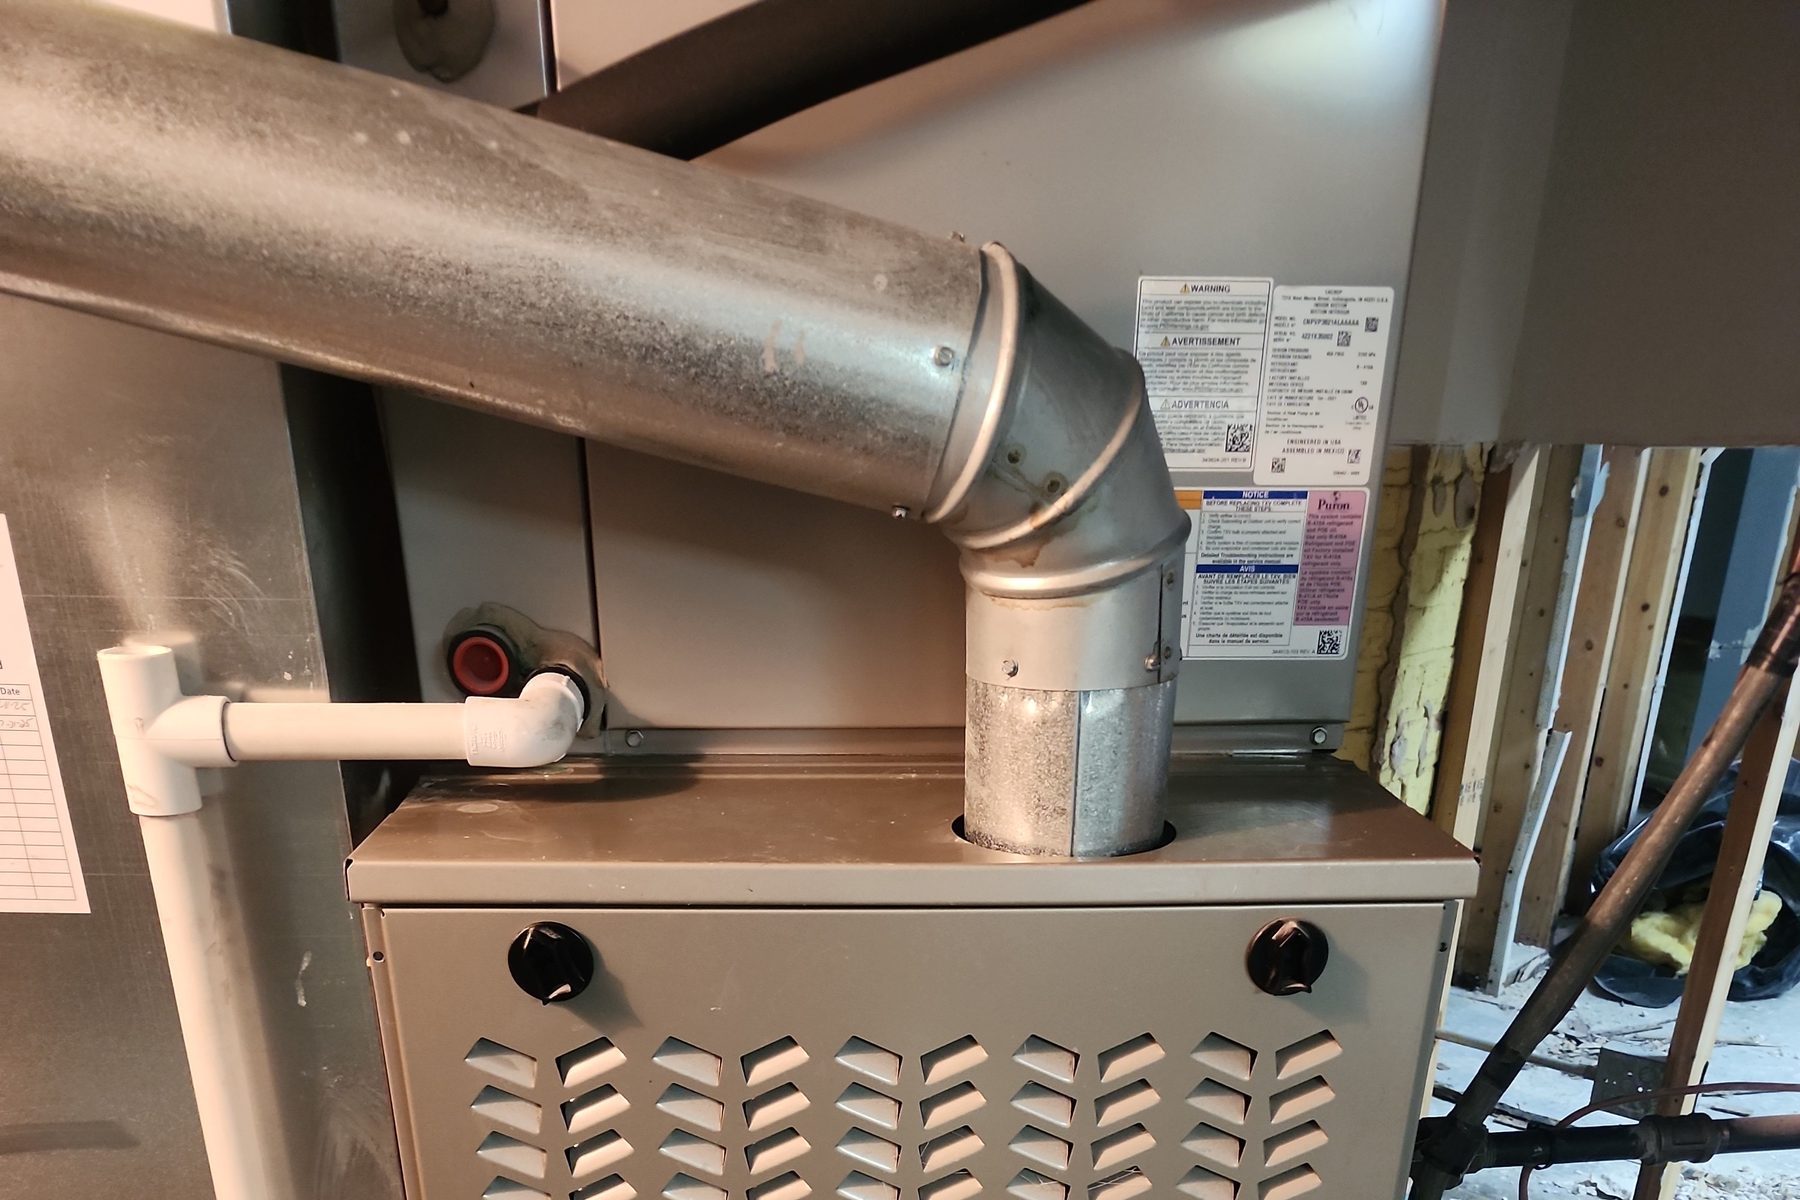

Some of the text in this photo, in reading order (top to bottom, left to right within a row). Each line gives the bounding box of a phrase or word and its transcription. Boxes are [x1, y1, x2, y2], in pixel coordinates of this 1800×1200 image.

[1191, 285, 1231, 293] WARNING
[1172, 337, 1241, 346] AVERTISSEMENT
[1172, 400, 1229, 409] ADVERTENCIA
[1242, 491, 1269, 499] NOTICE
[1318, 499, 1350, 510] Puron
